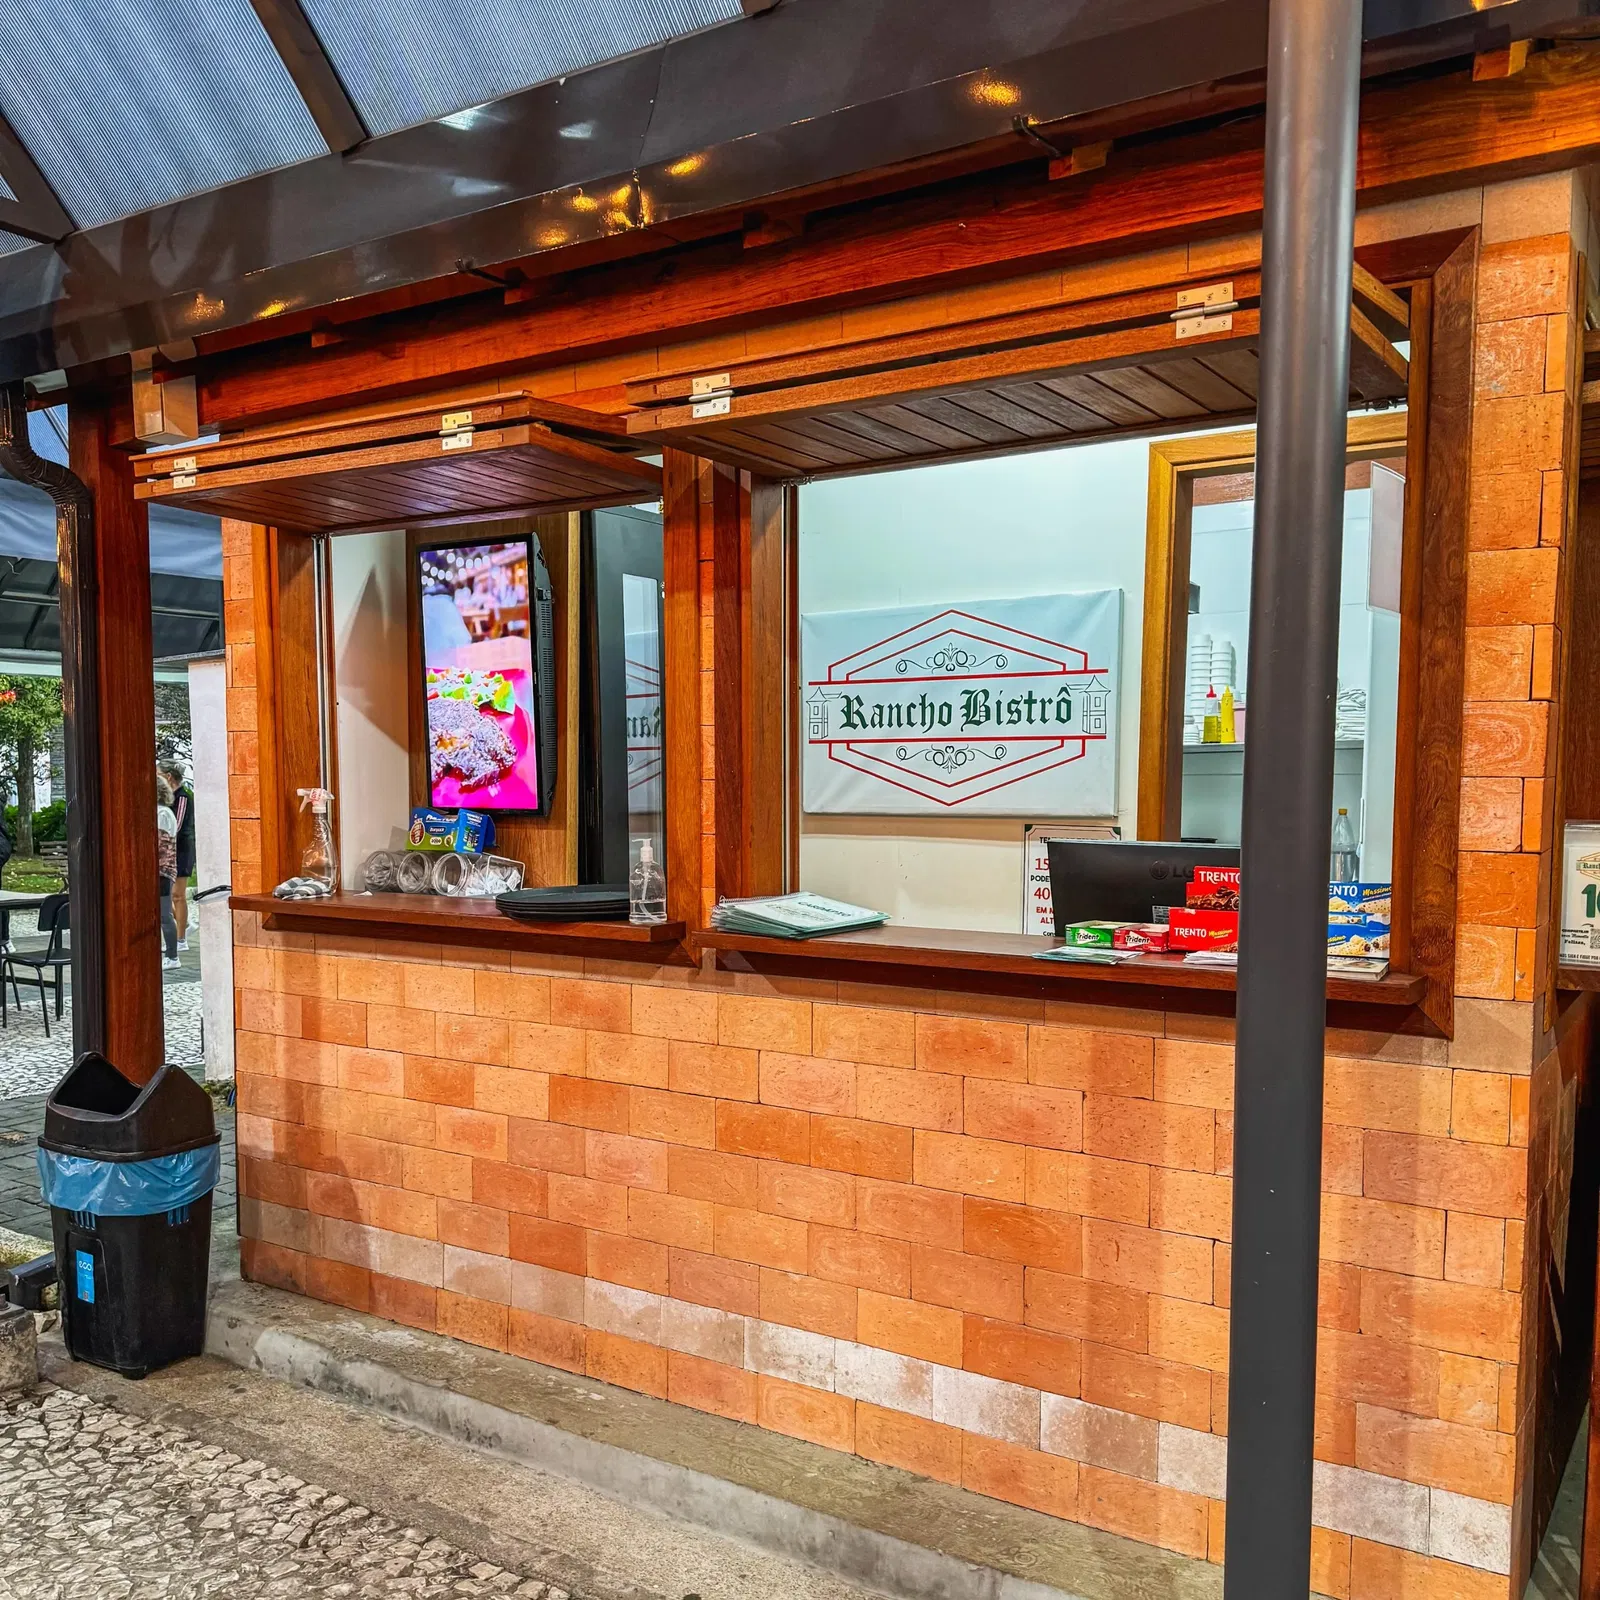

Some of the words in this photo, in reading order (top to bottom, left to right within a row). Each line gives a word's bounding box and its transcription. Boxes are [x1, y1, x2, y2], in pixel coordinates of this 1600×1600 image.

[839, 693, 953, 734] Rancho
[959, 688, 1072, 732] Bistrô
[1034, 887, 1050, 900] 40
[1076, 932, 1099, 940] Trident
[1174, 928, 1207, 938] TRENTO
[1126, 935, 1150, 943] Trident
